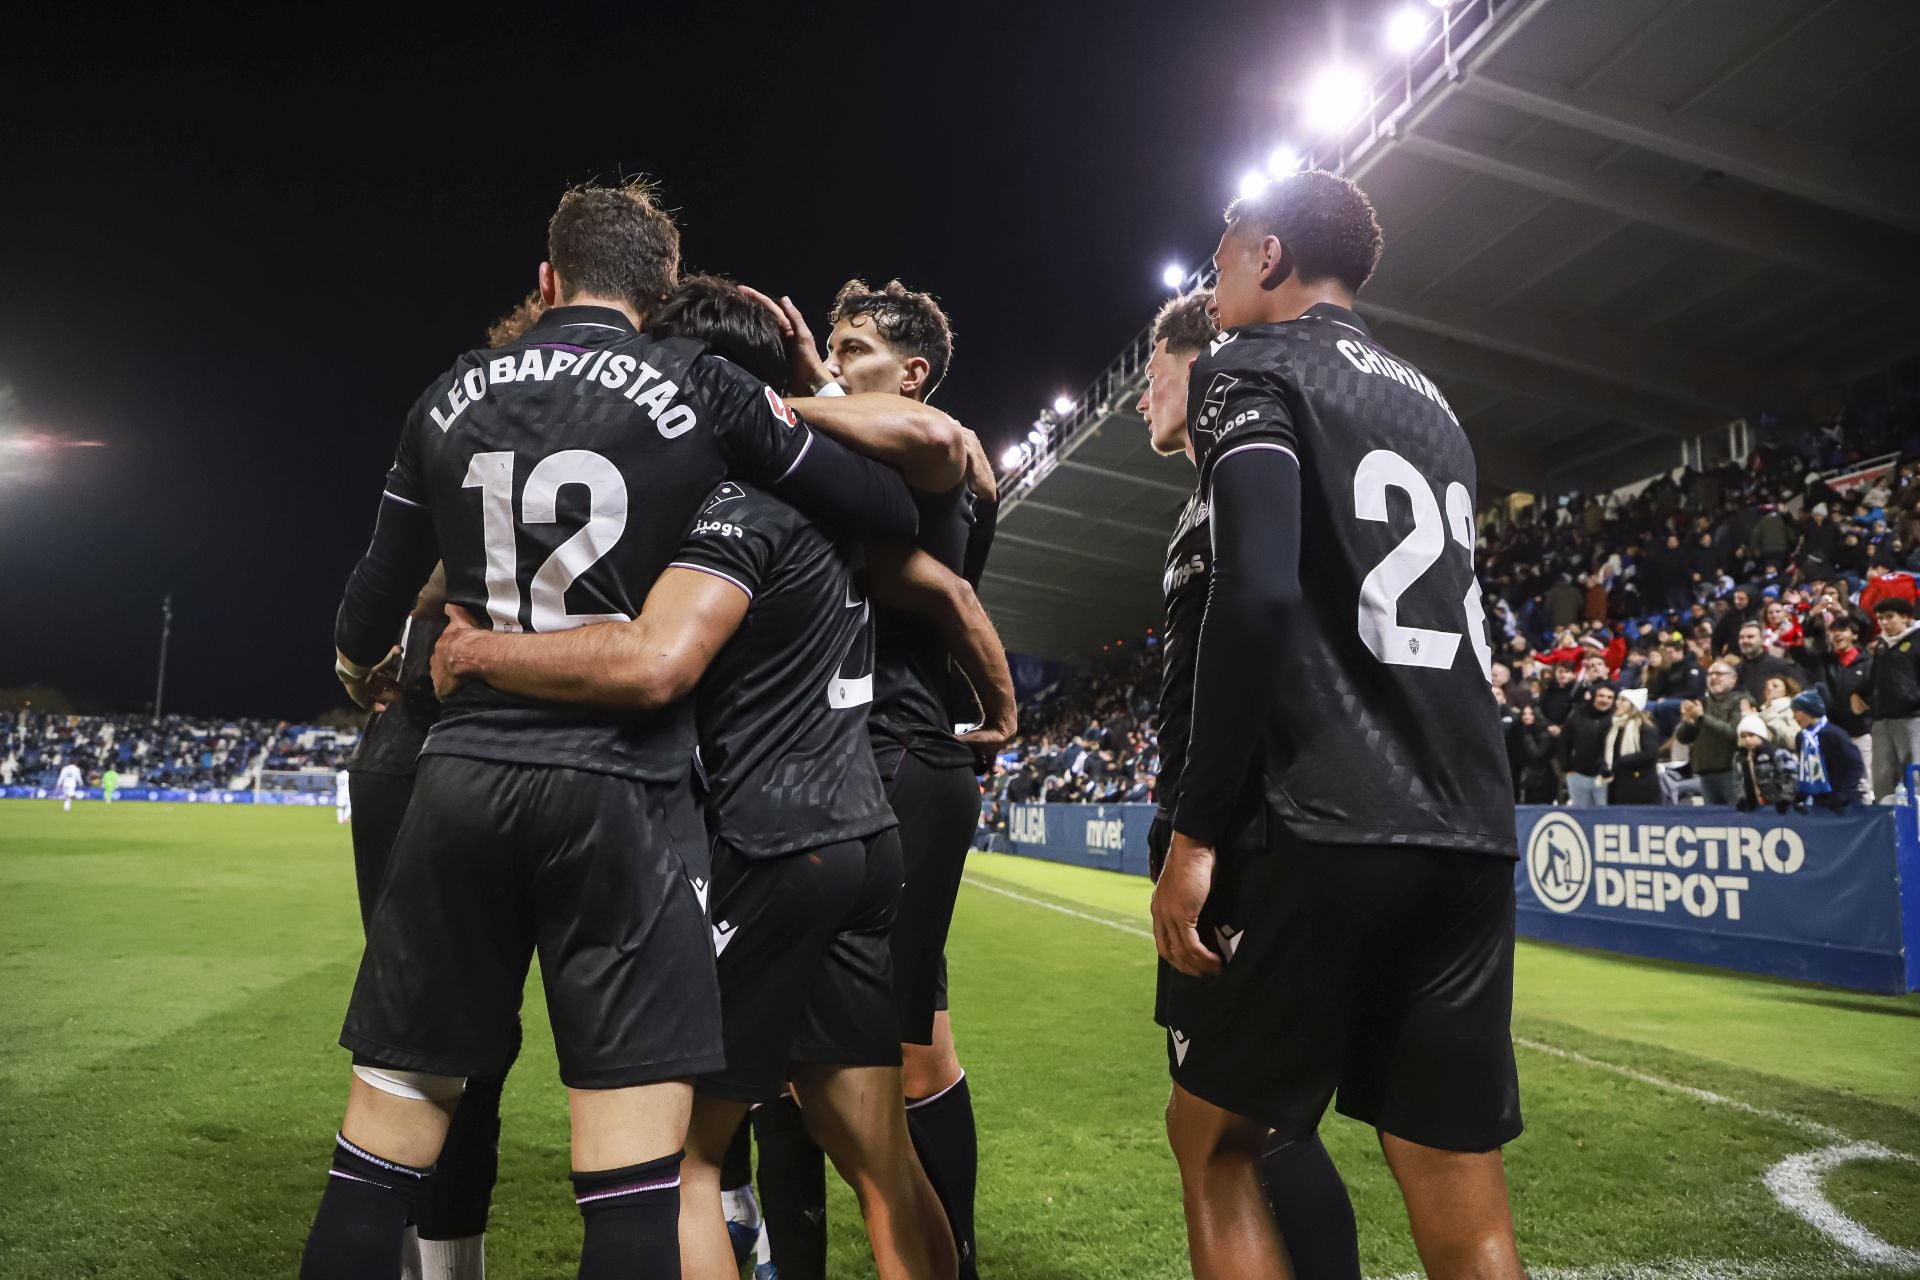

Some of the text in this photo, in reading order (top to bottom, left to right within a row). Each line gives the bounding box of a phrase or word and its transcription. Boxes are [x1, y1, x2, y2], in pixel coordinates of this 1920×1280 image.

[461, 449, 631, 634] 12
[1594, 824, 1805, 875] ELECTRO
[1595, 867, 1750, 921] DEPOT
